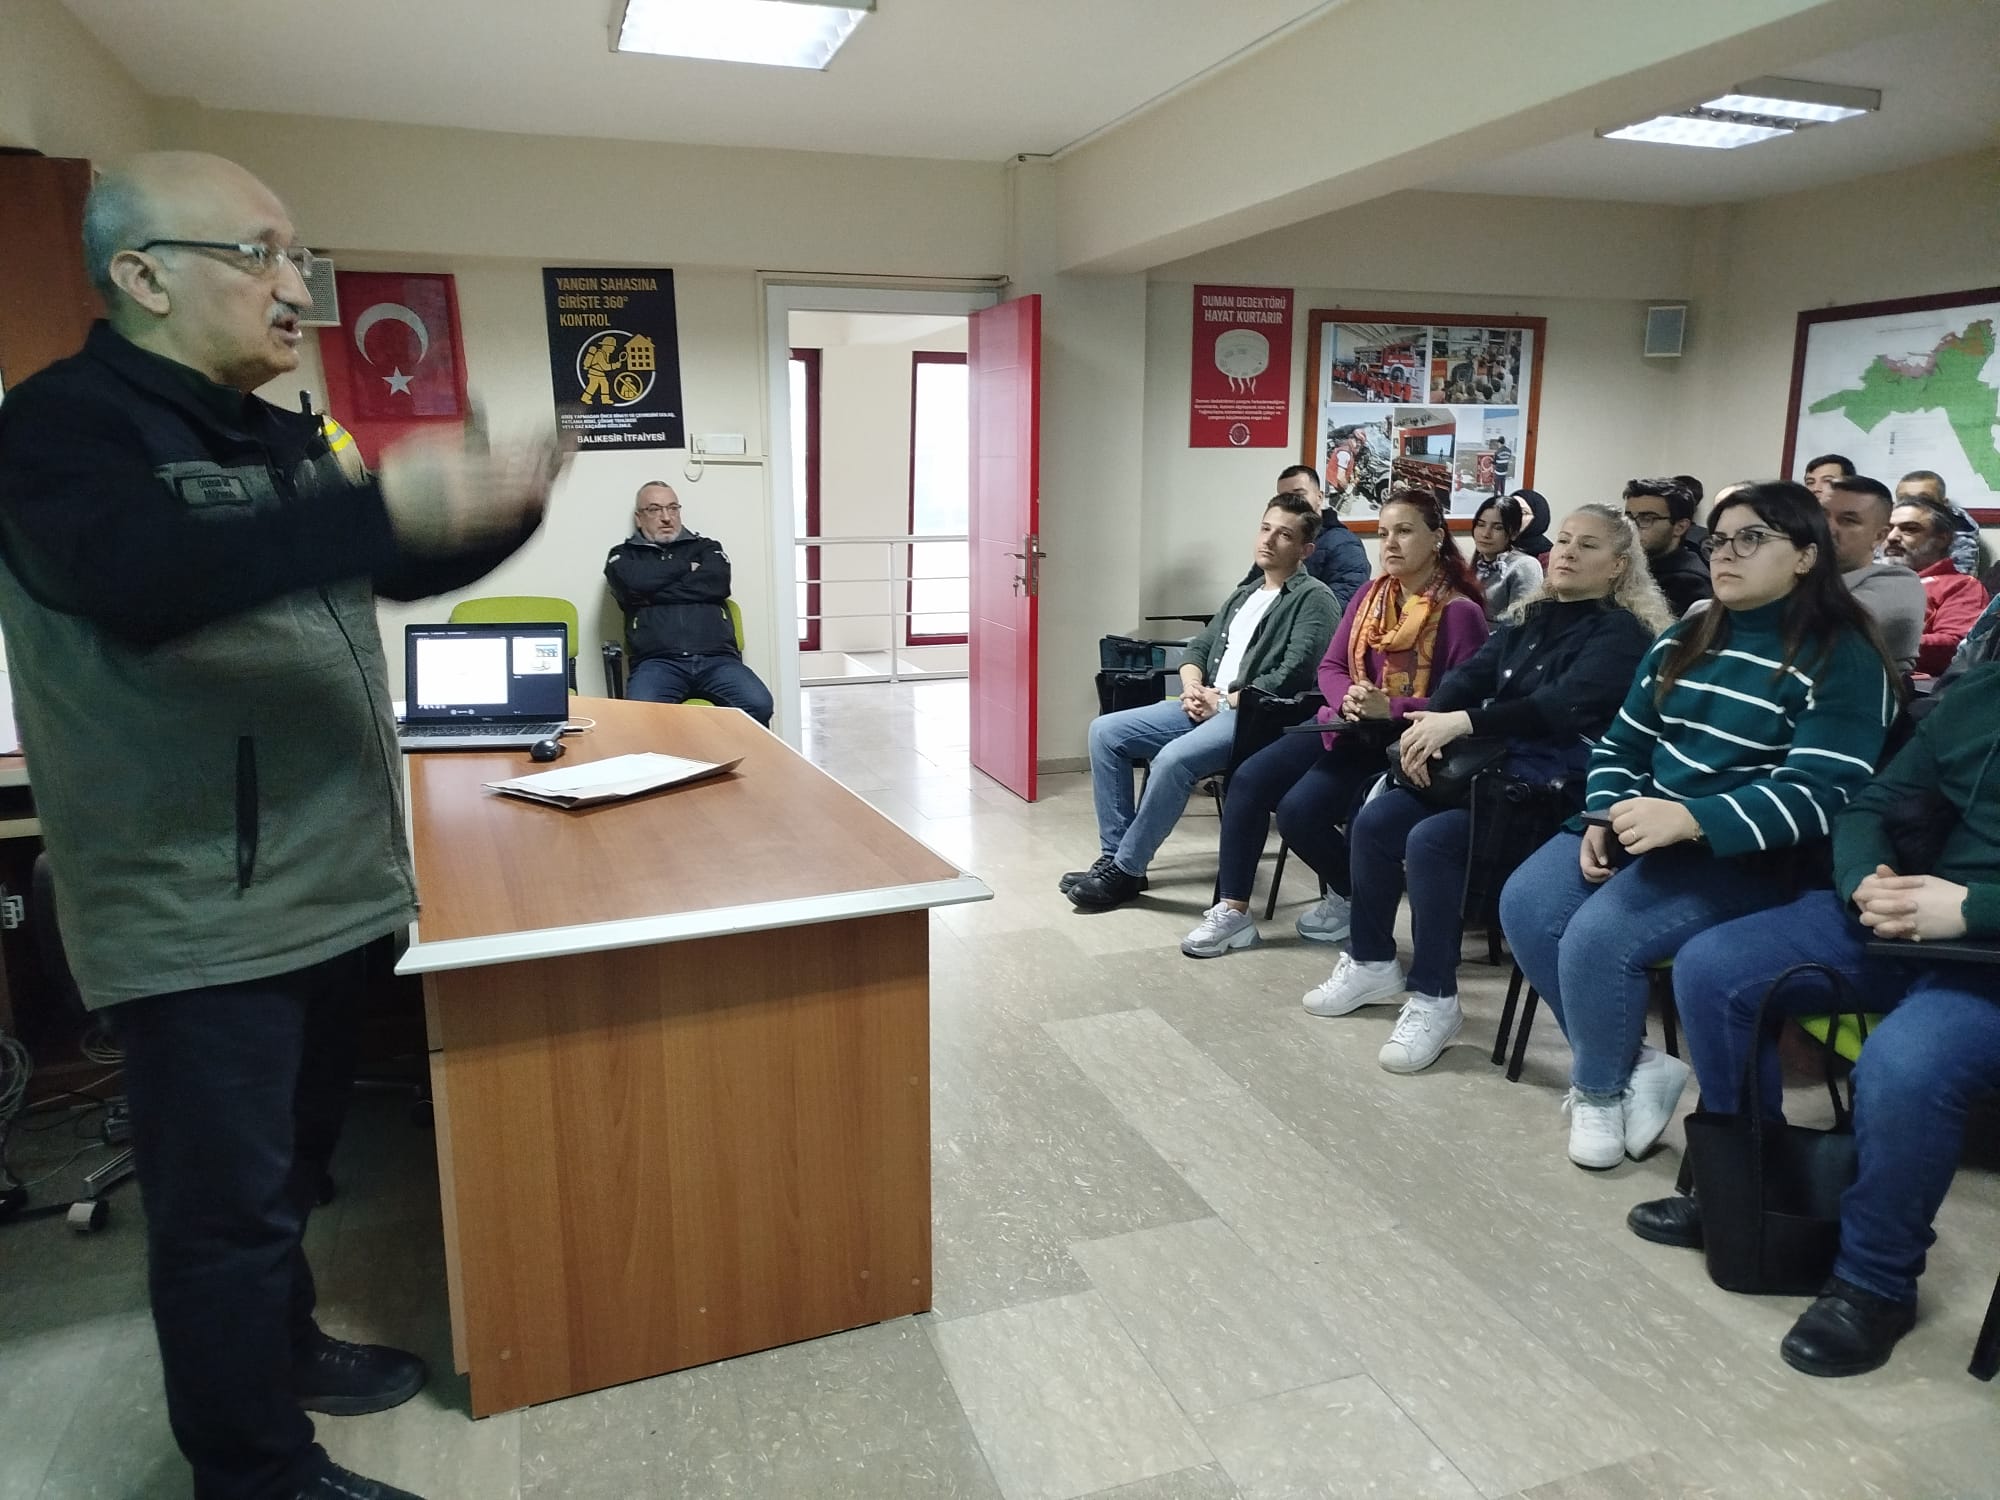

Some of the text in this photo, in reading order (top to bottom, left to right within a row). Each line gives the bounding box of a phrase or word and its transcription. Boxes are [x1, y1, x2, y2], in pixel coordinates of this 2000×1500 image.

[556, 277, 657, 291] YANGIN SAHASINA
[558, 294, 600, 310] GİRİŞTE
[1202, 295, 1286, 309] DUMAN DEDEKTÖRÜ
[560, 314, 610, 327] KONTROL
[1205, 309, 1282, 324] HAYAT KURTARIR
[577, 432, 666, 443] BALIKESİR İTFAİYESİ
